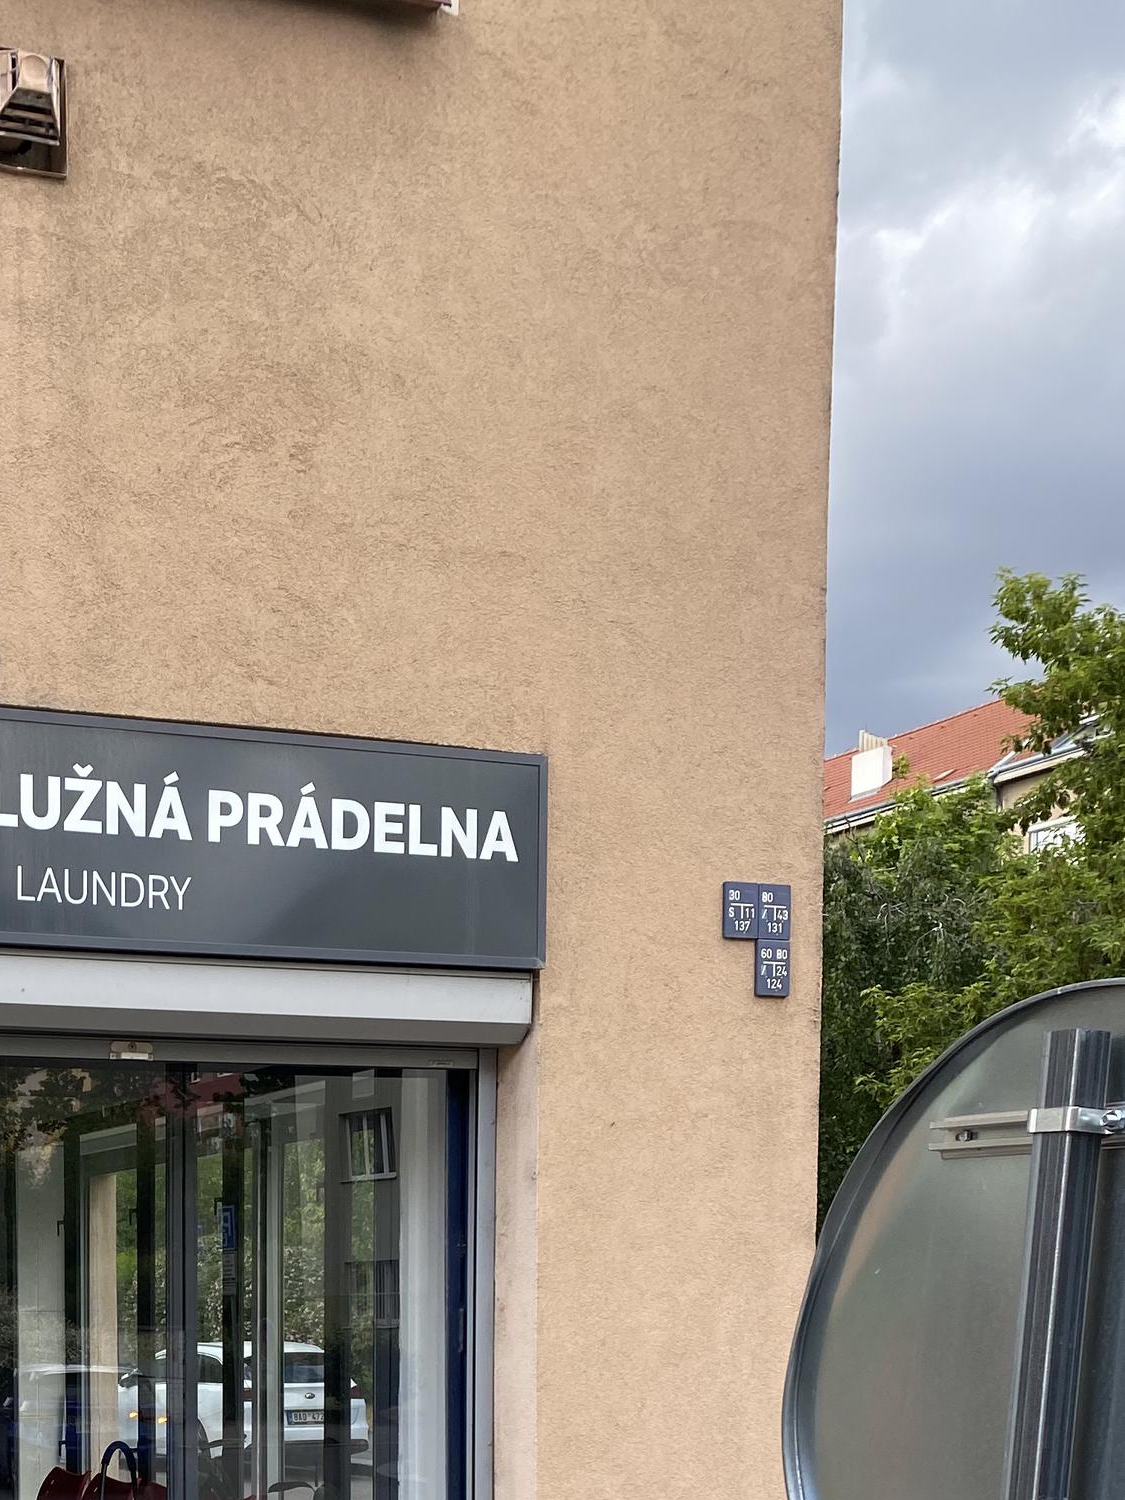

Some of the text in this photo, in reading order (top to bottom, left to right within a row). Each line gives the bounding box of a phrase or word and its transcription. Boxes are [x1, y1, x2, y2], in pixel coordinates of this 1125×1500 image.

[207, 781, 519, 862] PRÁDELNA
[16, 865, 192, 911] LAUNDRY
[728, 889, 741, 901] 30
[734, 920, 751, 932] 137
[767, 922, 783, 933] 131
[760, 948, 772, 959] 60
[776, 966, 787, 976] 24
[766, 978, 782, 989] 124
